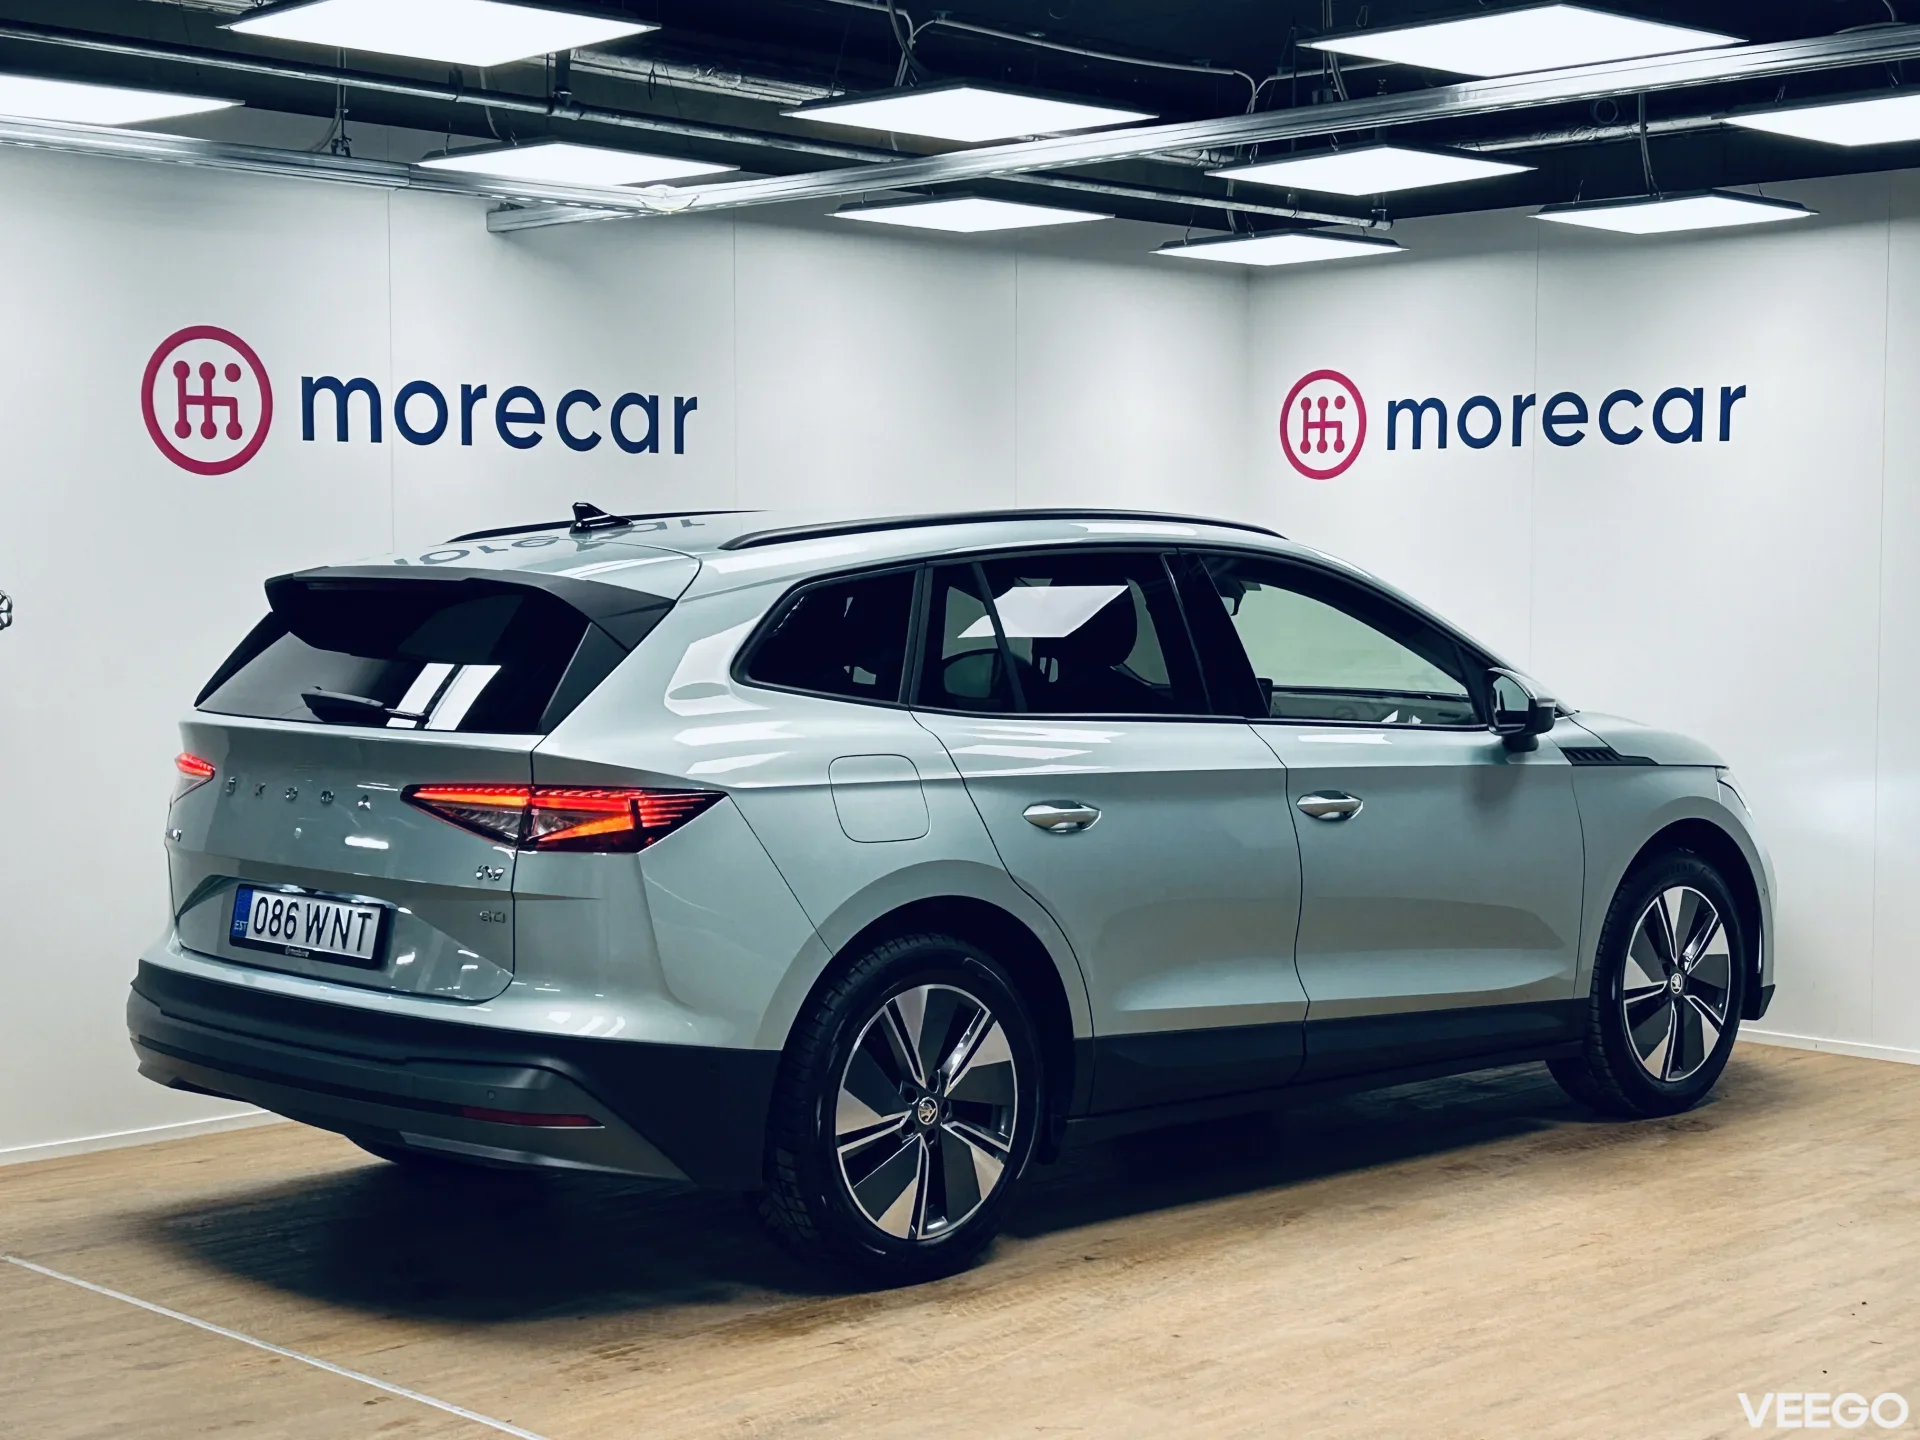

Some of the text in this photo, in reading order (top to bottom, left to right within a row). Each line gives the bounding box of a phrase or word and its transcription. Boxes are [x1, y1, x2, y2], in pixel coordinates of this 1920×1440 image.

[301, 375, 698, 455] morecar
[1386, 384, 1747, 451] morecar
[233, 920, 249, 932] EST
[253, 896, 373, 952] 086 WNT
